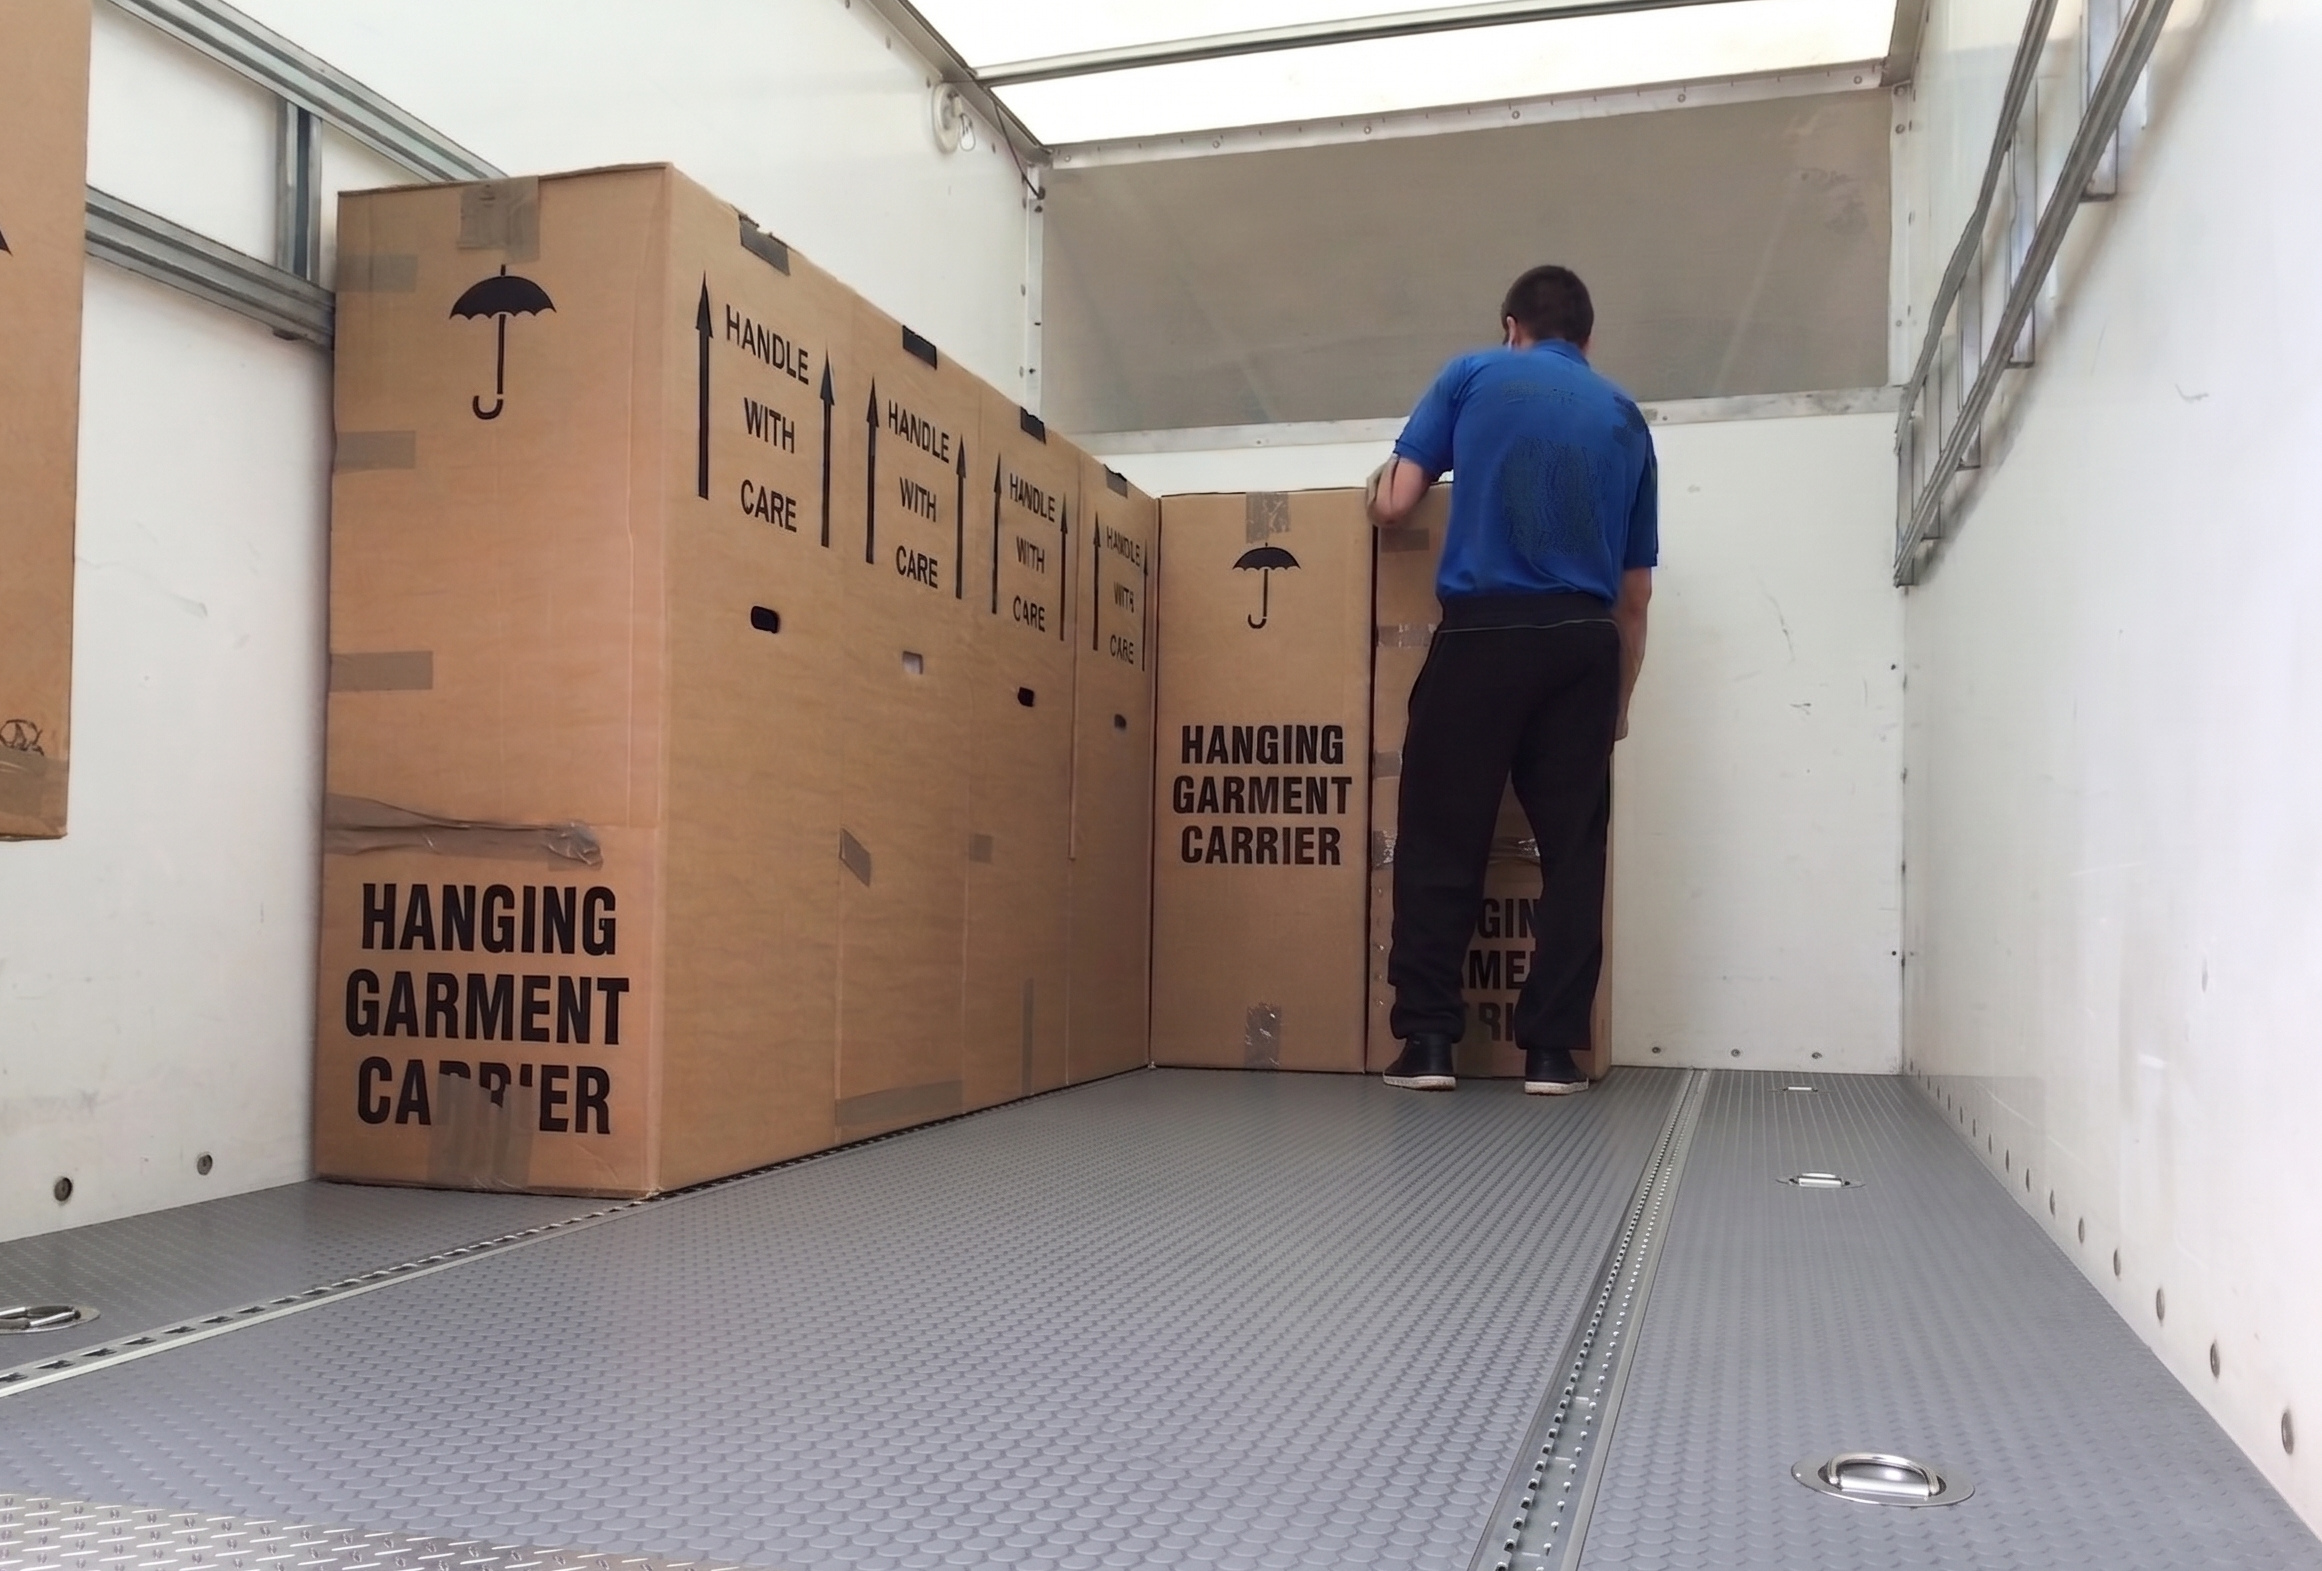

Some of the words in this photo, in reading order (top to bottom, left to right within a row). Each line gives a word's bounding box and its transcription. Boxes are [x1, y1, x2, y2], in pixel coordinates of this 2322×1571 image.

[726, 304, 809, 385] HANDLE
[744, 397, 795, 454] WITH
[888, 400, 950, 463] HANDLE
[740, 479, 797, 533] CARE
[899, 476, 938, 522] WITH
[1010, 473, 1056, 523] HANDLE
[896, 545, 938, 589] CARE
[1016, 535, 1045, 574] WITH
[1013, 595, 1046, 633] CARE
[1109, 634, 1134, 665] CARE
[1181, 724, 1345, 766] HANGING
[1172, 775, 1353, 815] GARMENT
[1180, 825, 1342, 866] CARRIER
[362, 883, 616, 956] HANGING
[345, 968, 630, 1045] GARMENT
[357, 1056, 611, 1134] CAER
